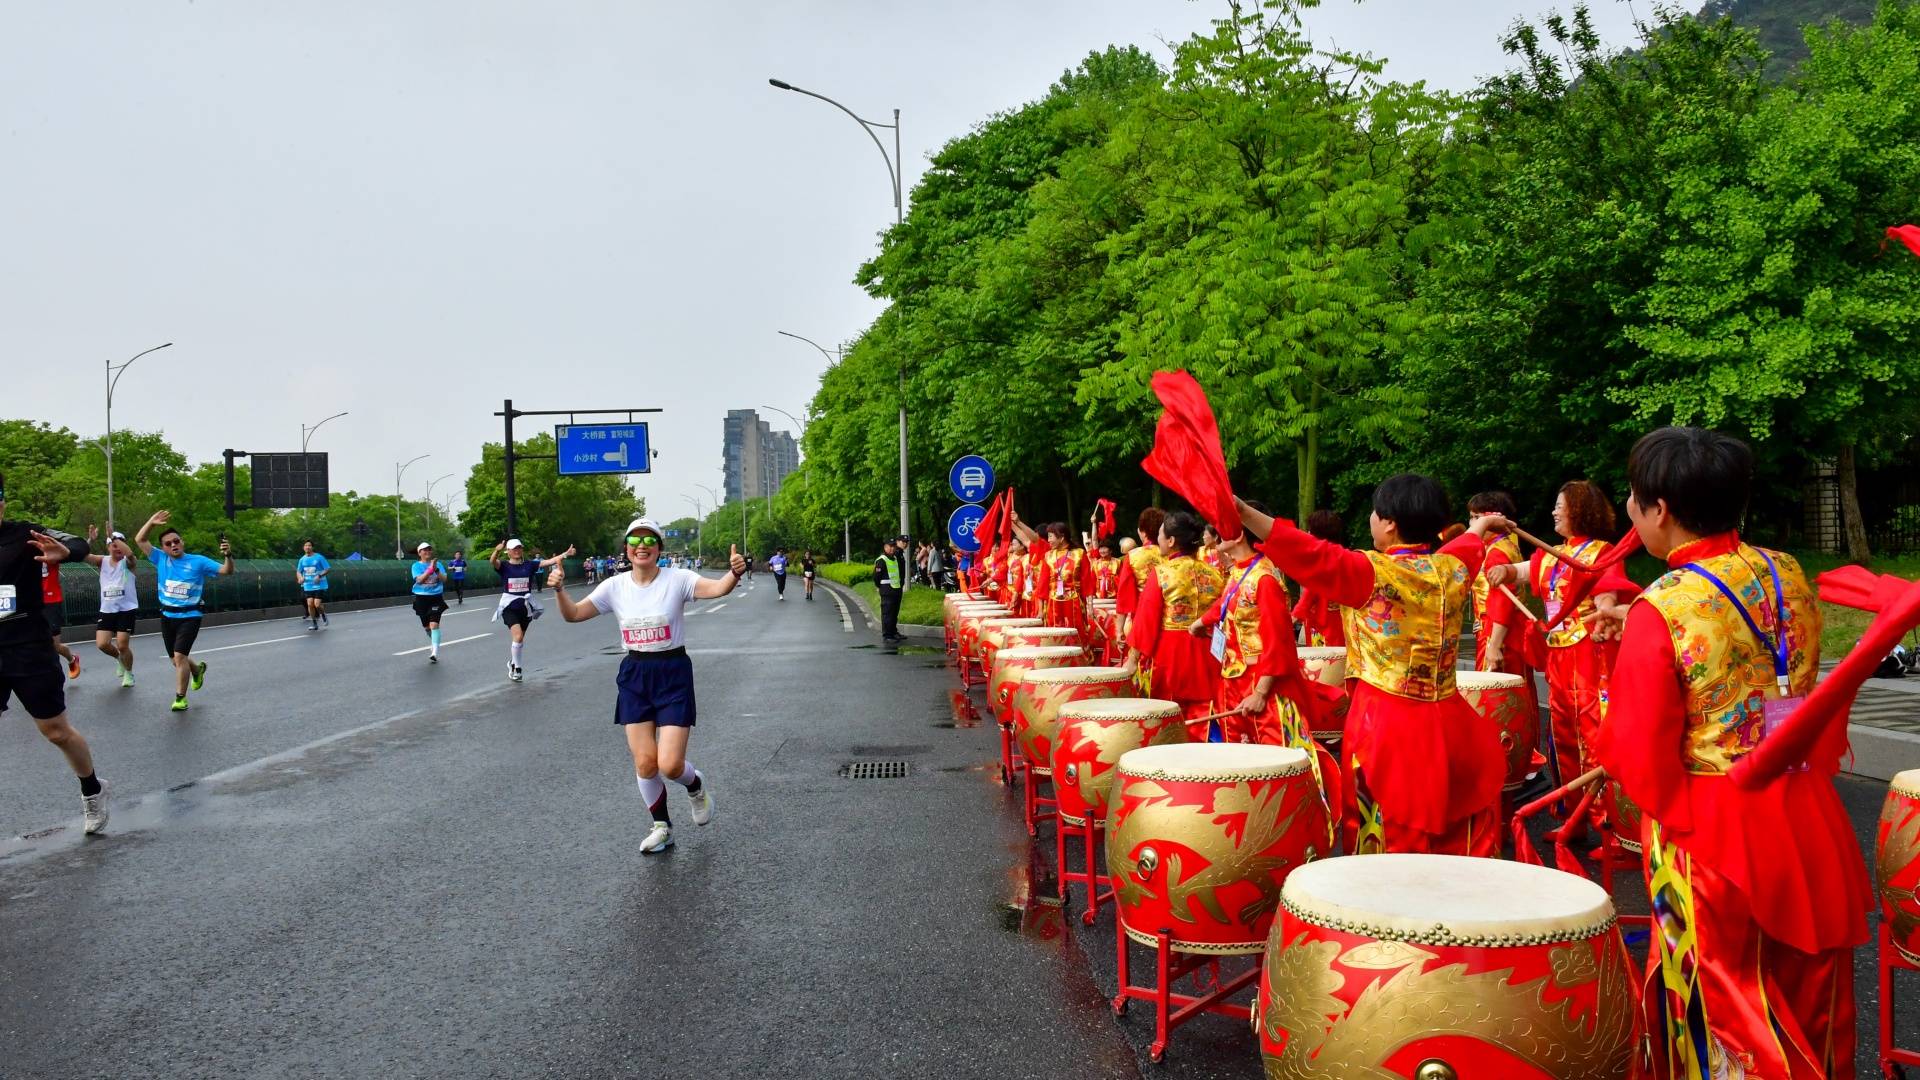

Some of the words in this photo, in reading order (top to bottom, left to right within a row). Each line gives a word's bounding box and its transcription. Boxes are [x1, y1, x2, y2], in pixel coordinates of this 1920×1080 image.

[582, 431, 606, 439] 大桥路
[574, 453, 597, 463] 小沙村
[628, 627, 666, 641] A50070
